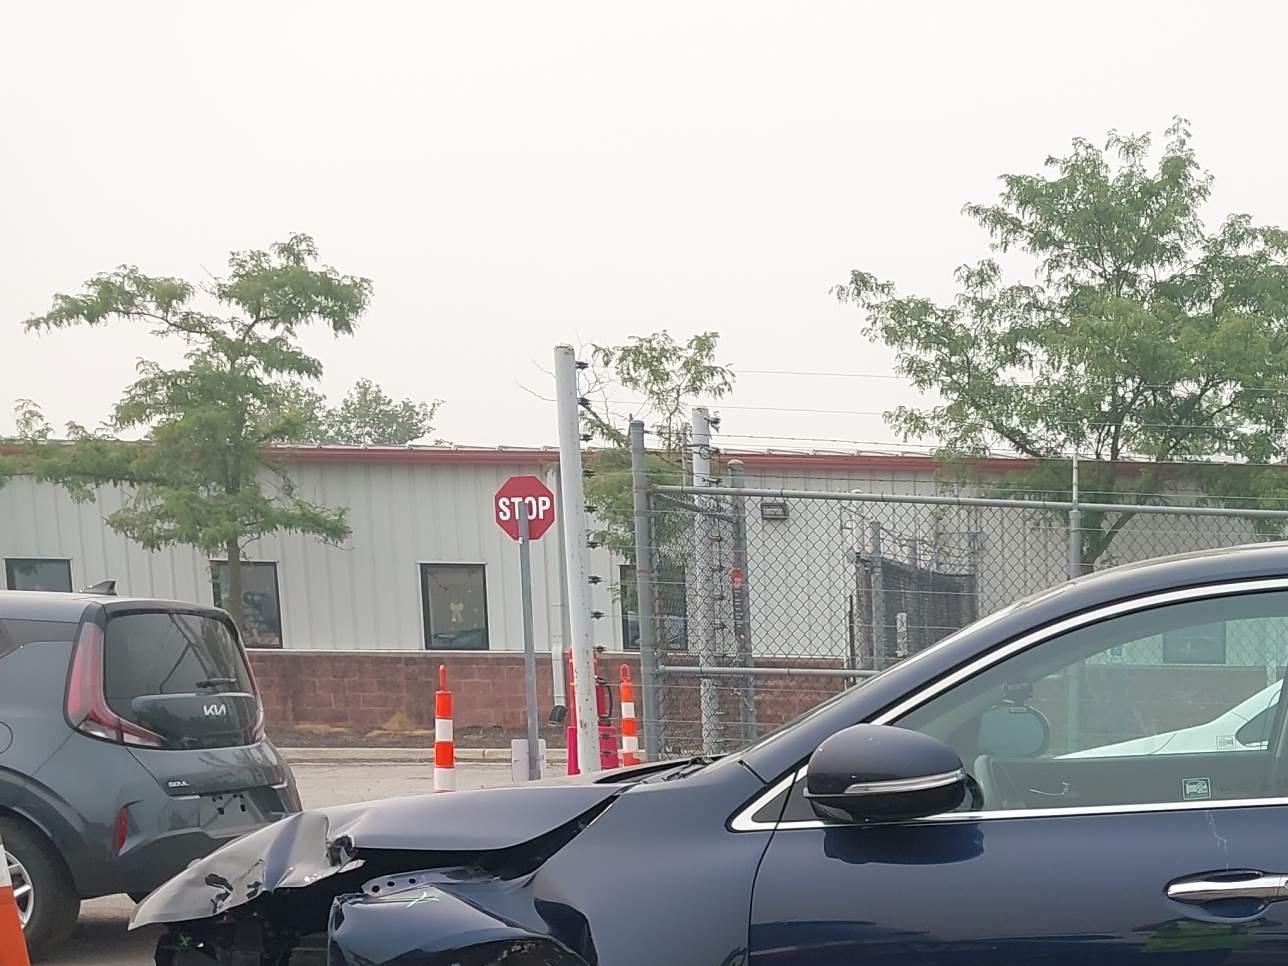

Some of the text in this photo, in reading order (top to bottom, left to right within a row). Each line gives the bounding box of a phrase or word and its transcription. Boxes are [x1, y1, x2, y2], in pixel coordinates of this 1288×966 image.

[498, 495, 551, 521] STOP
[203, 703, 226, 716] KIA
[168, 780, 189, 789] SOUL
